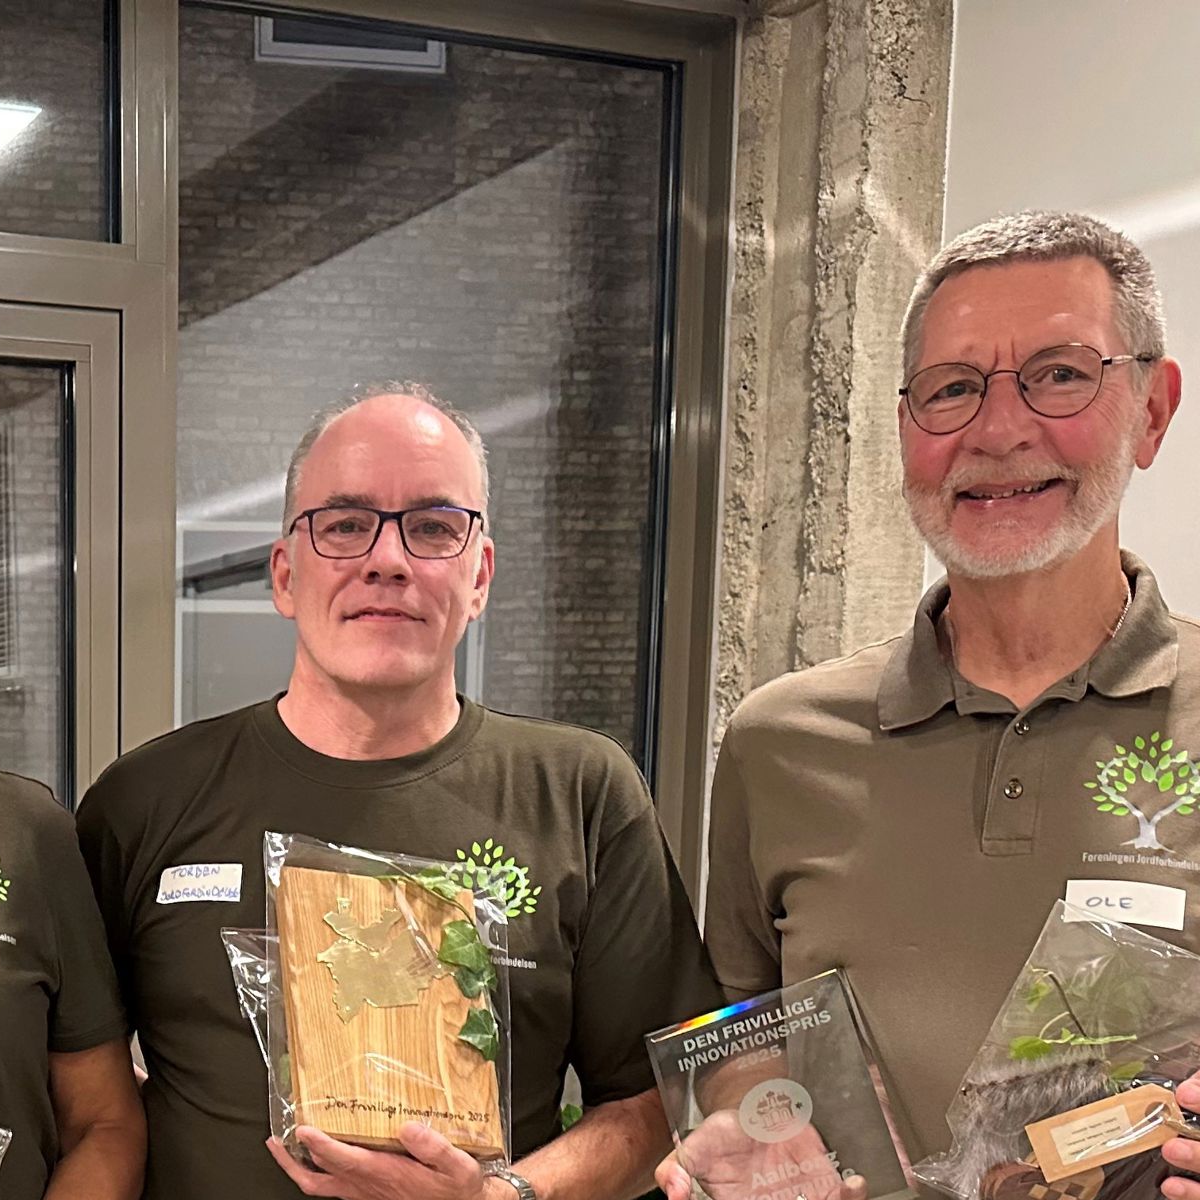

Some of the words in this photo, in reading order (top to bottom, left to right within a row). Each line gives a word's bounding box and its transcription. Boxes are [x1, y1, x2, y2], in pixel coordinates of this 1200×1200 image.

[1082, 852, 1135, 864] Foreningen
[1136, 854, 1200, 871] Jordforbindels
[1085, 897, 1134, 909] OLE
[683, 1030, 719, 1053] DEN
[722, 997, 817, 1040] FRIVILLIGE
[677, 1010, 832, 1073] INNOVATIONSPRIS
[737, 1044, 782, 1071] 2025
[325, 1095, 347, 1110] Den
[468, 1110, 490, 1123] 2025
